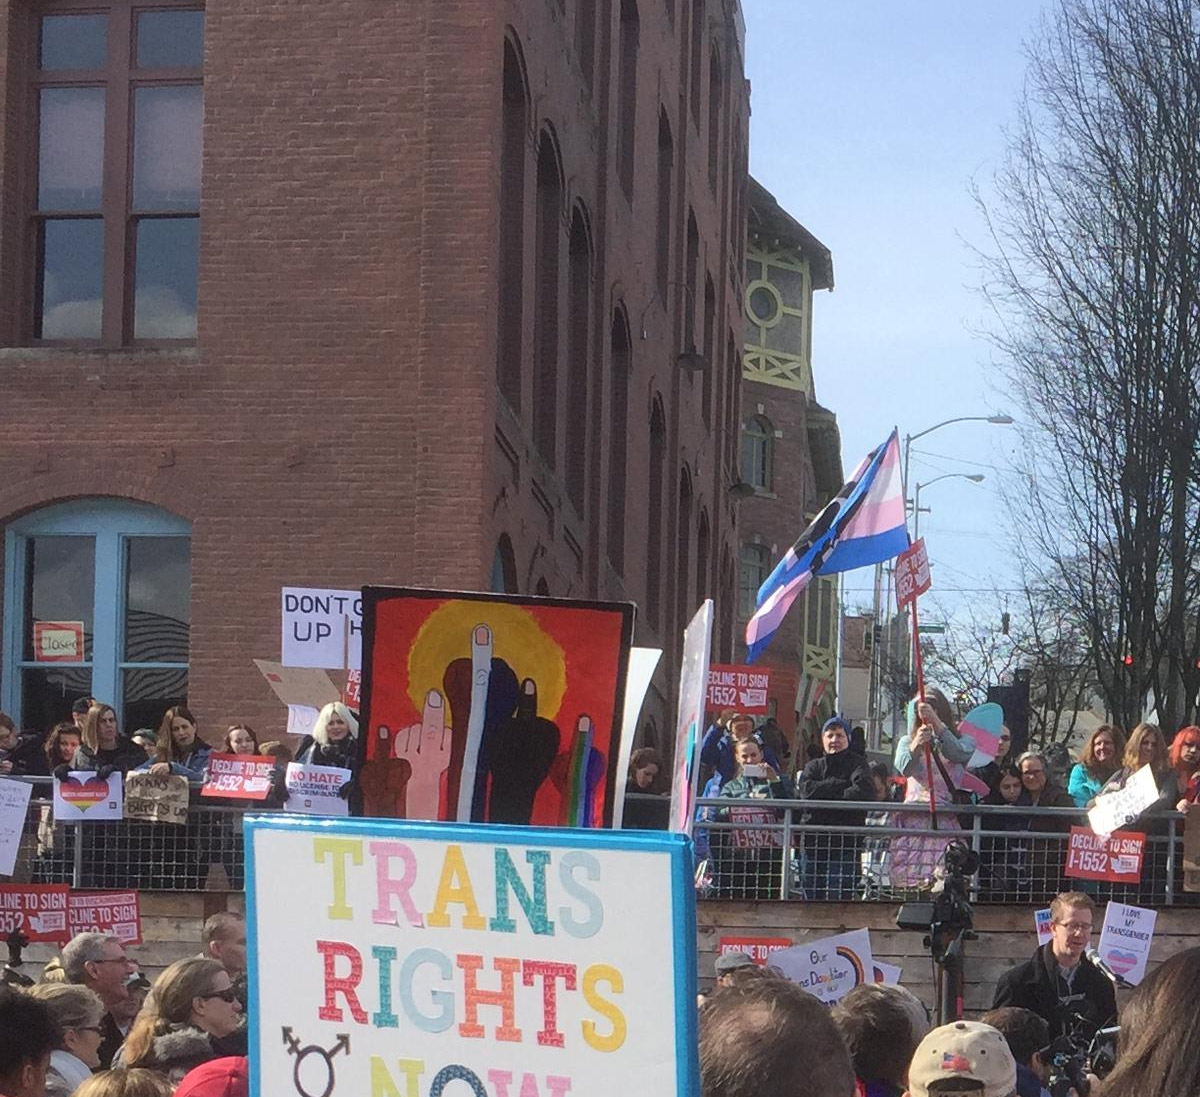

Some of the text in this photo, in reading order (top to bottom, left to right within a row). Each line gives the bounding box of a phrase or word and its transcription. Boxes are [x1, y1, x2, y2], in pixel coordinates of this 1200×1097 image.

[285, 594, 349, 614] DON'T
[294, 621, 332, 643] UP
[707, 671, 769, 688] ECLINE TO SIGN
[706, 686, 736, 706] -1552
[212, 759, 245, 776] DECLINE
[246, 761, 256, 776] TO
[290, 770, 343, 783] NO HATE
[1072, 833, 1143, 855] DECLINE TO SIGN
[1069, 850, 1108, 873] I-1552
[314, 838, 604, 939] TRANS
[24, 893, 38, 909] TO
[41, 892, 66, 909] SIGN
[69, 904, 137, 924] CLINE TO SIGN
[1126, 908, 1142, 918] LOVE
[1106, 924, 1150, 940] TRANSGENDER
[757, 945, 767, 960] TO
[316, 940, 627, 1054] RIGHTS
